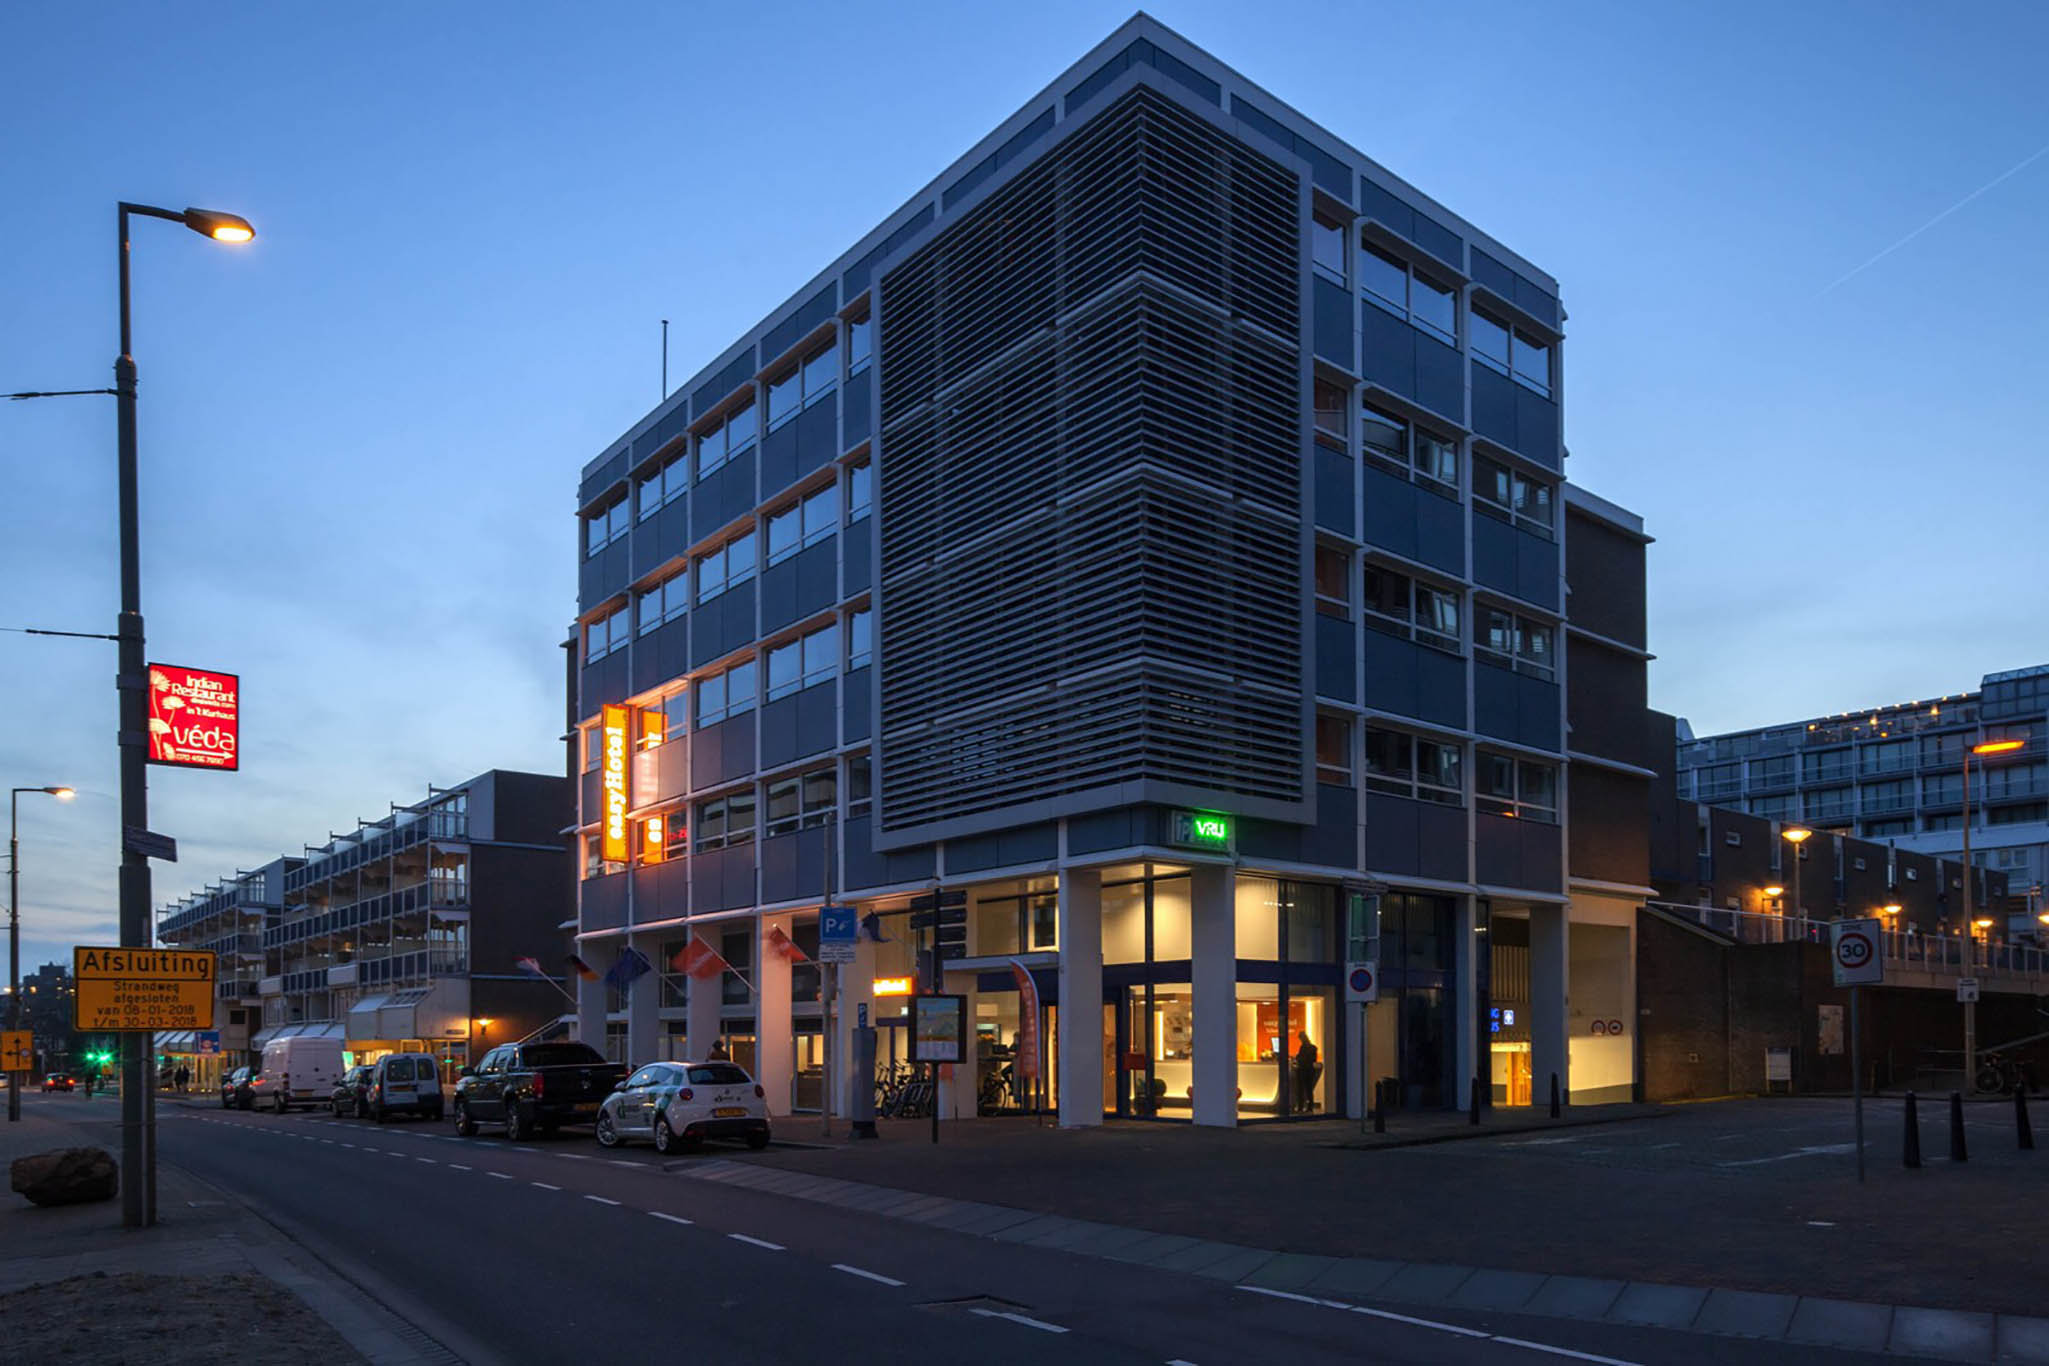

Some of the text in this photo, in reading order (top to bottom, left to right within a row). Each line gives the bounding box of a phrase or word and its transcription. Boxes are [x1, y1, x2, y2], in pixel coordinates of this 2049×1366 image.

[186, 674, 223, 691] Indian
[171, 683, 235, 703] Restaurant
[173, 725, 235, 751] véda
[606, 727, 626, 840] easyHotel
[825, 917, 838, 933] P
[1841, 943, 1865, 958] 30
[83, 951, 209, 978] Afsluiting
[113, 981, 179, 993] Strandweg
[114, 993, 179, 1004] afgesloten
[97, 1006, 119, 1015] van
[93, 1016, 197, 1027] t/m 30-03-2018
